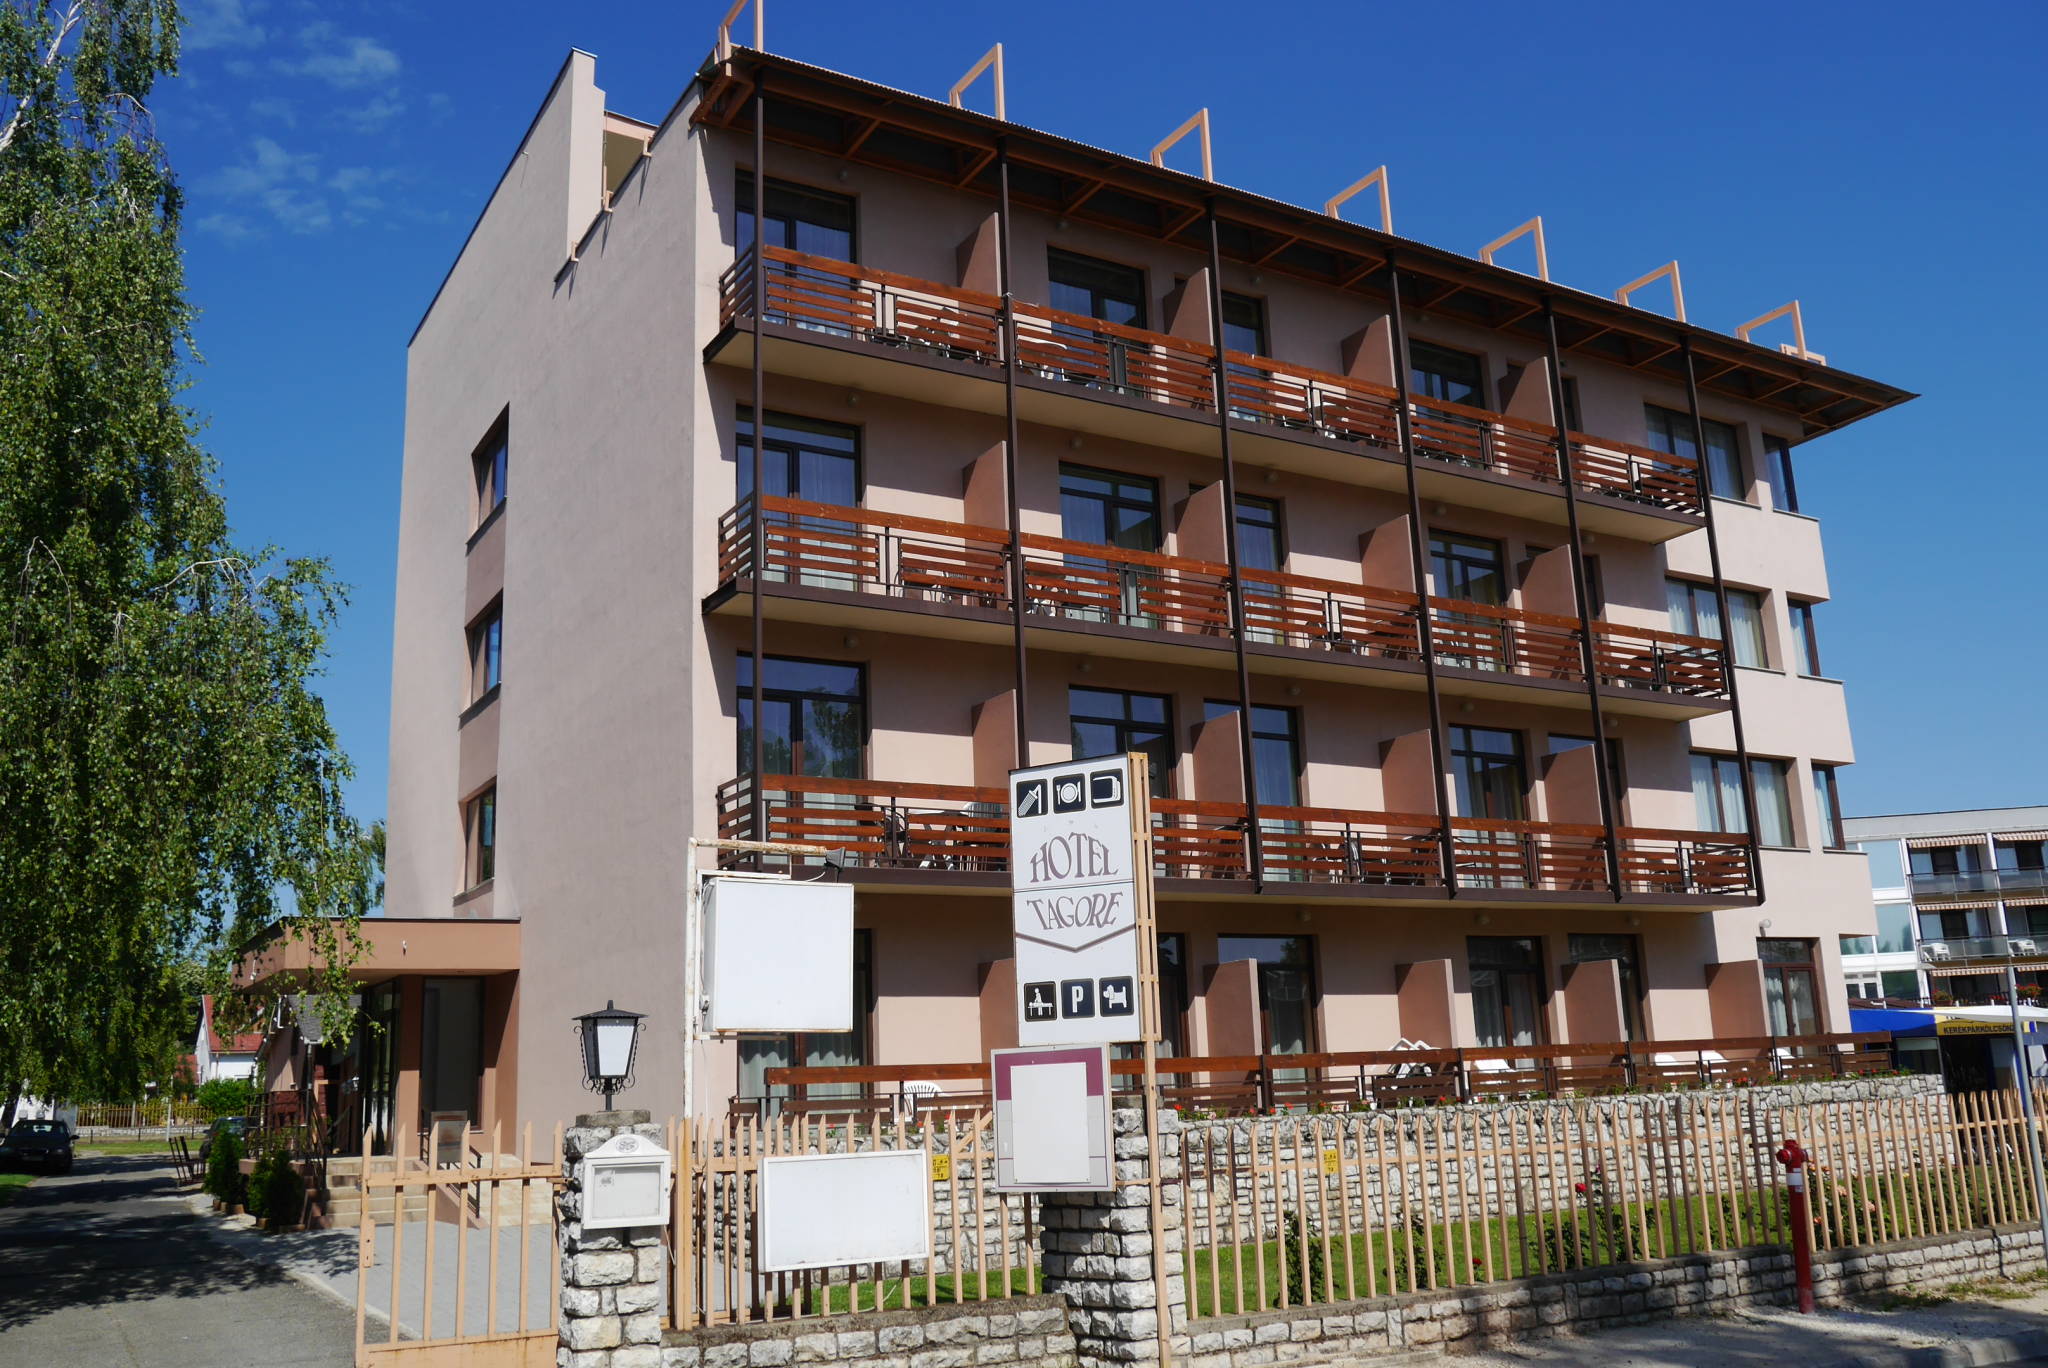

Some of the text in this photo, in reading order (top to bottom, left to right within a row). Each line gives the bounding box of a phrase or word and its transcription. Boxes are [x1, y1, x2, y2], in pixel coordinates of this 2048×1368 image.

[1030, 831, 1119, 884] HOTEL
[1026, 891, 1124, 931] TAGORE
[1071, 985, 1084, 1013] P
